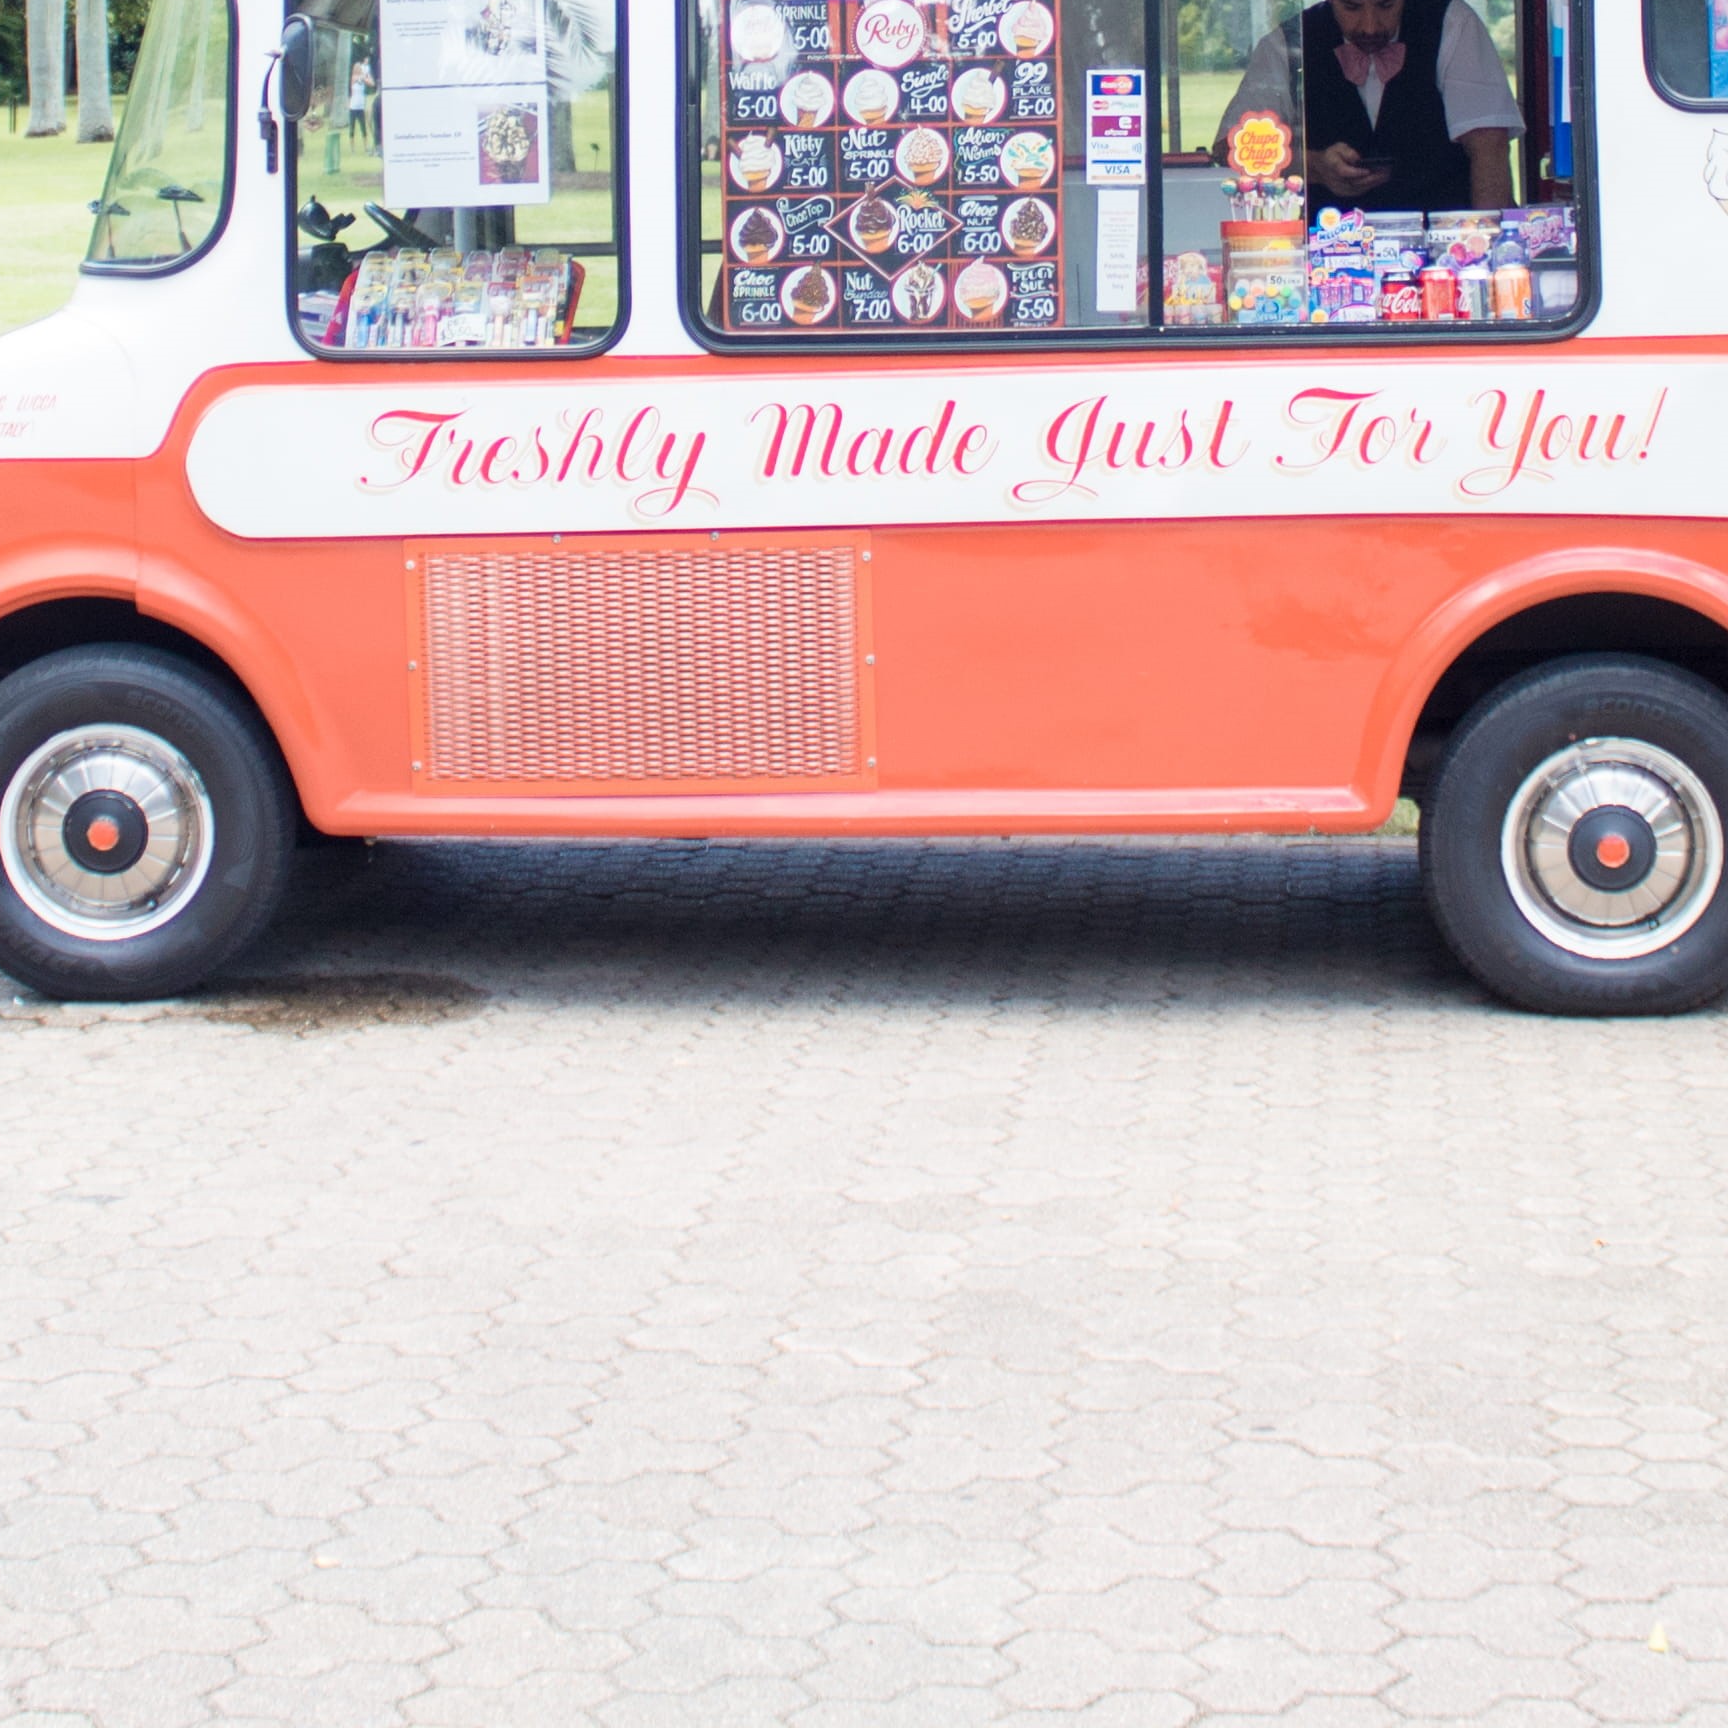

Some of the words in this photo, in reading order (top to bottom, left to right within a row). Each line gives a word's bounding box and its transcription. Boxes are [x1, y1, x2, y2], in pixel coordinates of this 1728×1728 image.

[862, 13, 919, 50] Ruby
[728, 71, 777, 91] Waffle
[900, 64, 950, 97] Single
[1012, 86, 1052, 97] FLAKE
[840, 126, 888, 152] Nut
[957, 126, 1005, 145] Alien
[1239, 131, 1280, 147] Chupa
[783, 133, 825, 159] Kitty
[842, 148, 895, 161] SPRINKLE
[958, 143, 1002, 162] Worms
[790, 157, 818, 167] CAT
[1237, 146, 1280, 167] Chups
[1104, 165, 1131, 176] VISA
[959, 200, 999, 217] Choc
[897, 204, 946, 233] Rocket
[966, 217, 993, 227] NUT
[733, 270, 776, 287] Choc
[844, 271, 873, 291] Nut
[1018, 279, 1046, 293] SUE
[733, 285, 776, 298] SPRINKLE
[843, 290, 888, 301] Sundae
[359, 405, 721, 518] Freshly
[749, 399, 1000, 479] Made
[1011, 394, 1250, 503] Just
[1275, 386, 1446, 469] For
[1460, 386, 1669, 496] You!
